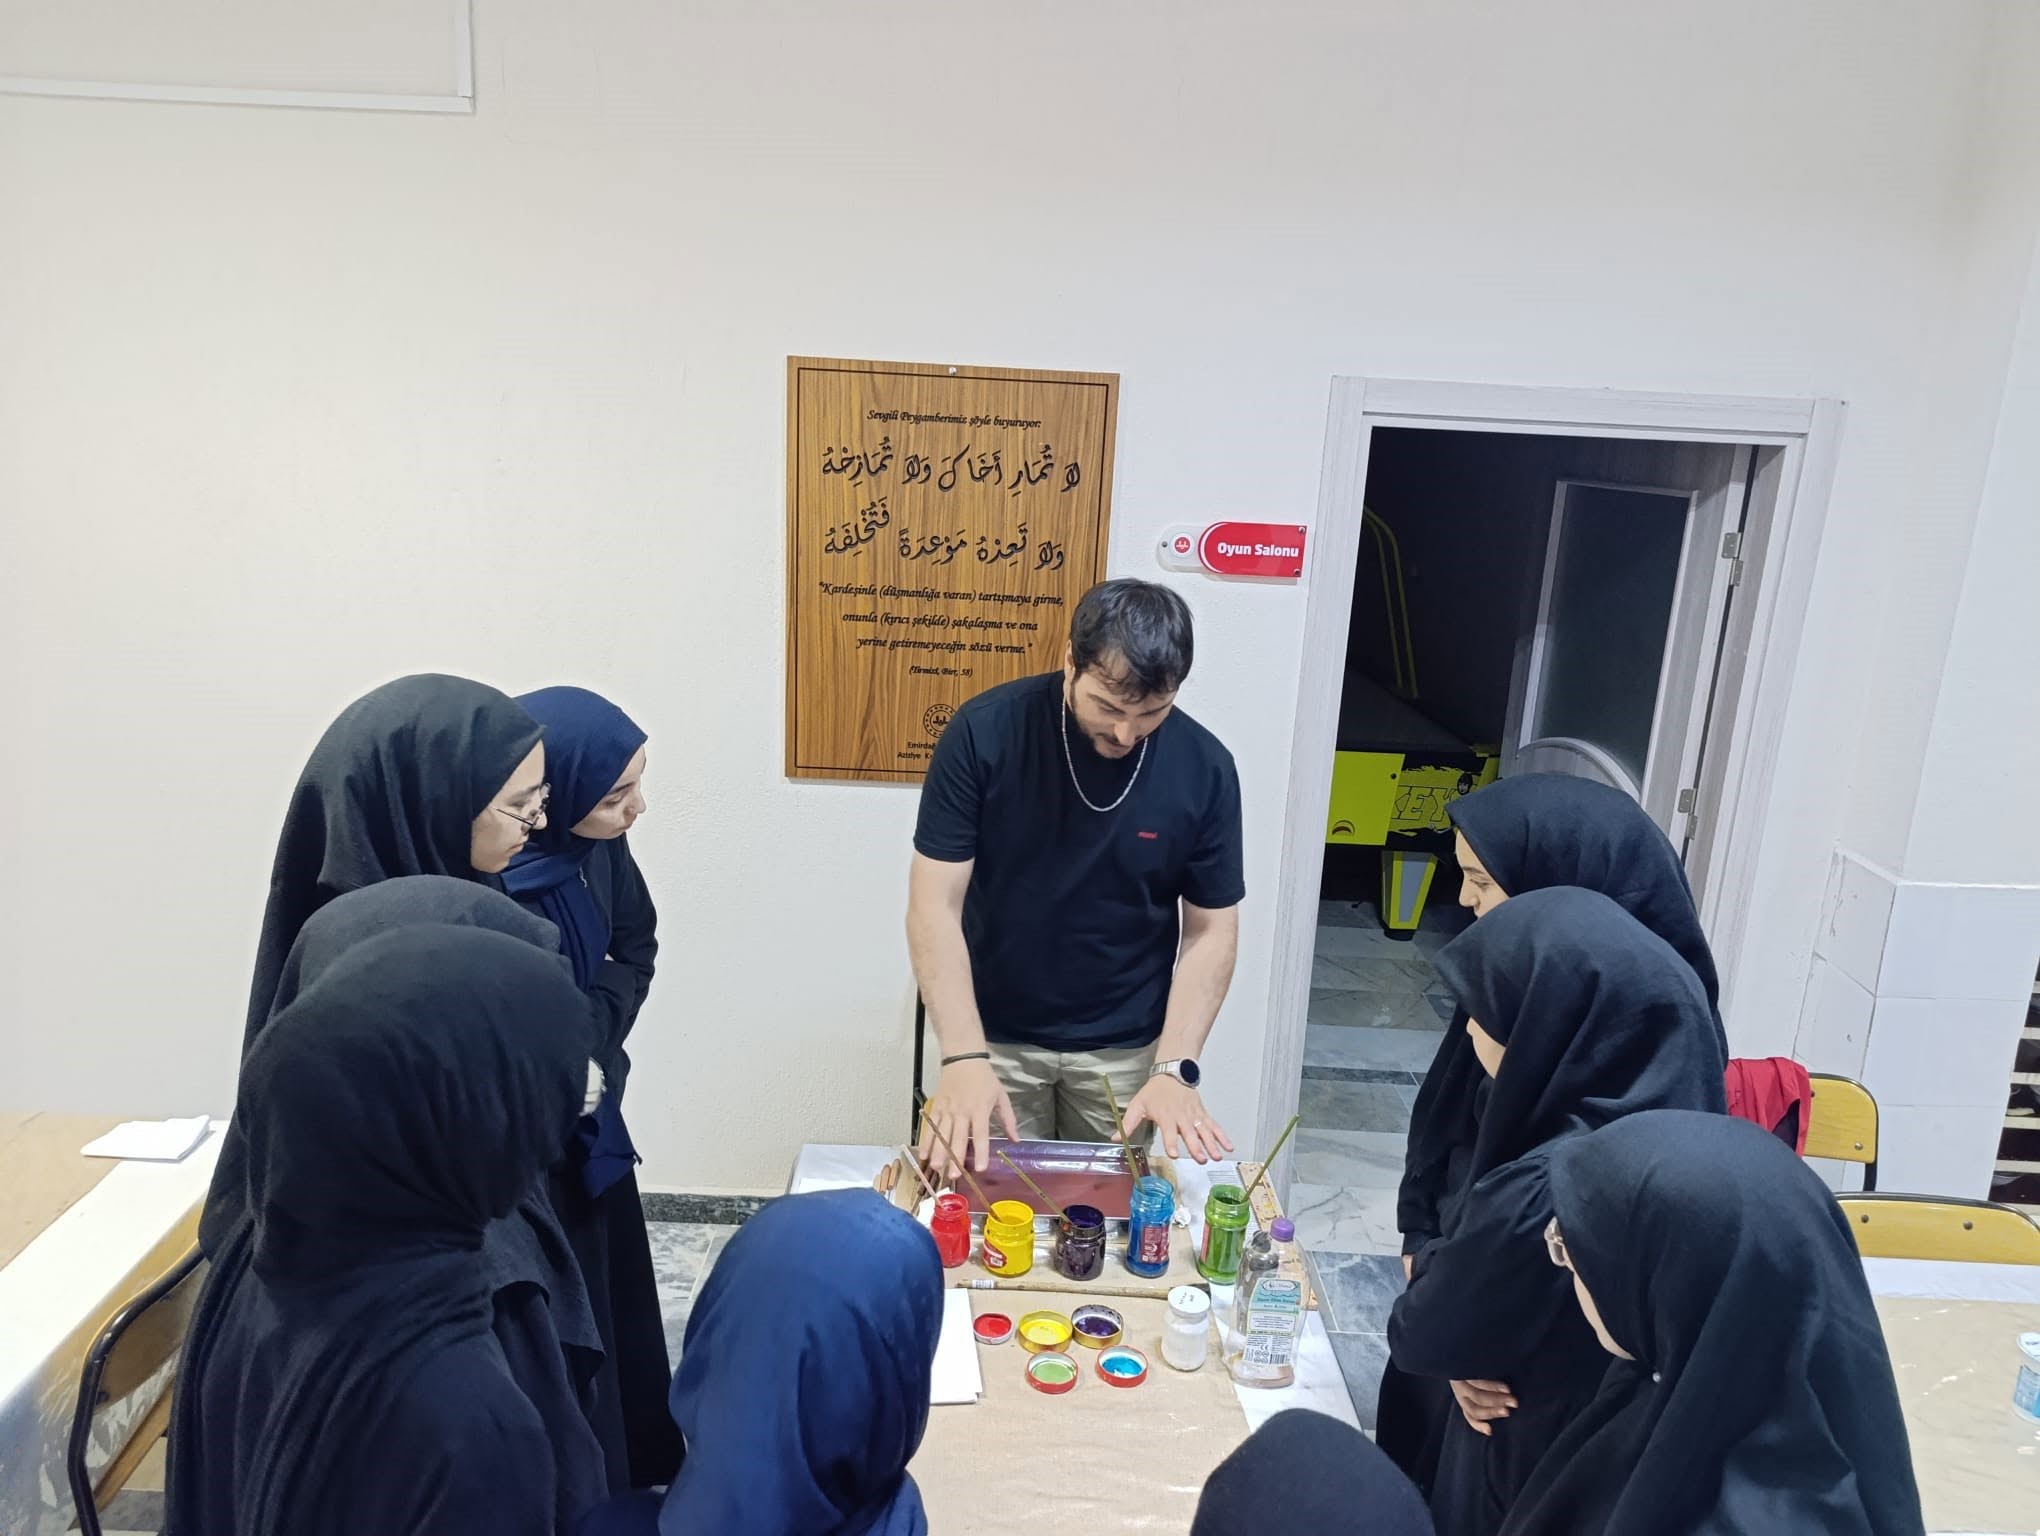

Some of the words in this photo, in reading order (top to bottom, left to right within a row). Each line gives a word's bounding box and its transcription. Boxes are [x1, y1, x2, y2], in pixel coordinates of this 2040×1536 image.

[867, 410, 899, 423] Sevgili
[900, 411, 967, 425] Peygamberimiz
[969, 414, 992, 428] şöyle
[994, 415, 1042, 430] buyuruyor:
[1217, 542, 1251, 557] Oyun
[1254, 543, 1299, 558] Salonu
[879, 583, 941, 602] (düşmanlığa
[943, 588, 976, 605] varan)
[978, 591, 1032, 607] tartışmaya
[1033, 593, 1064, 607] girme,
[842, 610, 878, 623] onunla
[880, 612, 911, 626] (kırıcı
[912, 613, 950, 630] şekilde)
[951, 616, 1003, 631] şakalaşma
[1005, 621, 1019, 630] ve
[1019, 622, 1038, 631] ona
[856, 636, 888, 650] yerine
[888, 638, 966, 654] getiremeyeceğin
[968, 641, 993, 653] sözü
[960, 667, 974, 679] 58)
[897, 751, 921, 760] Aziziye
